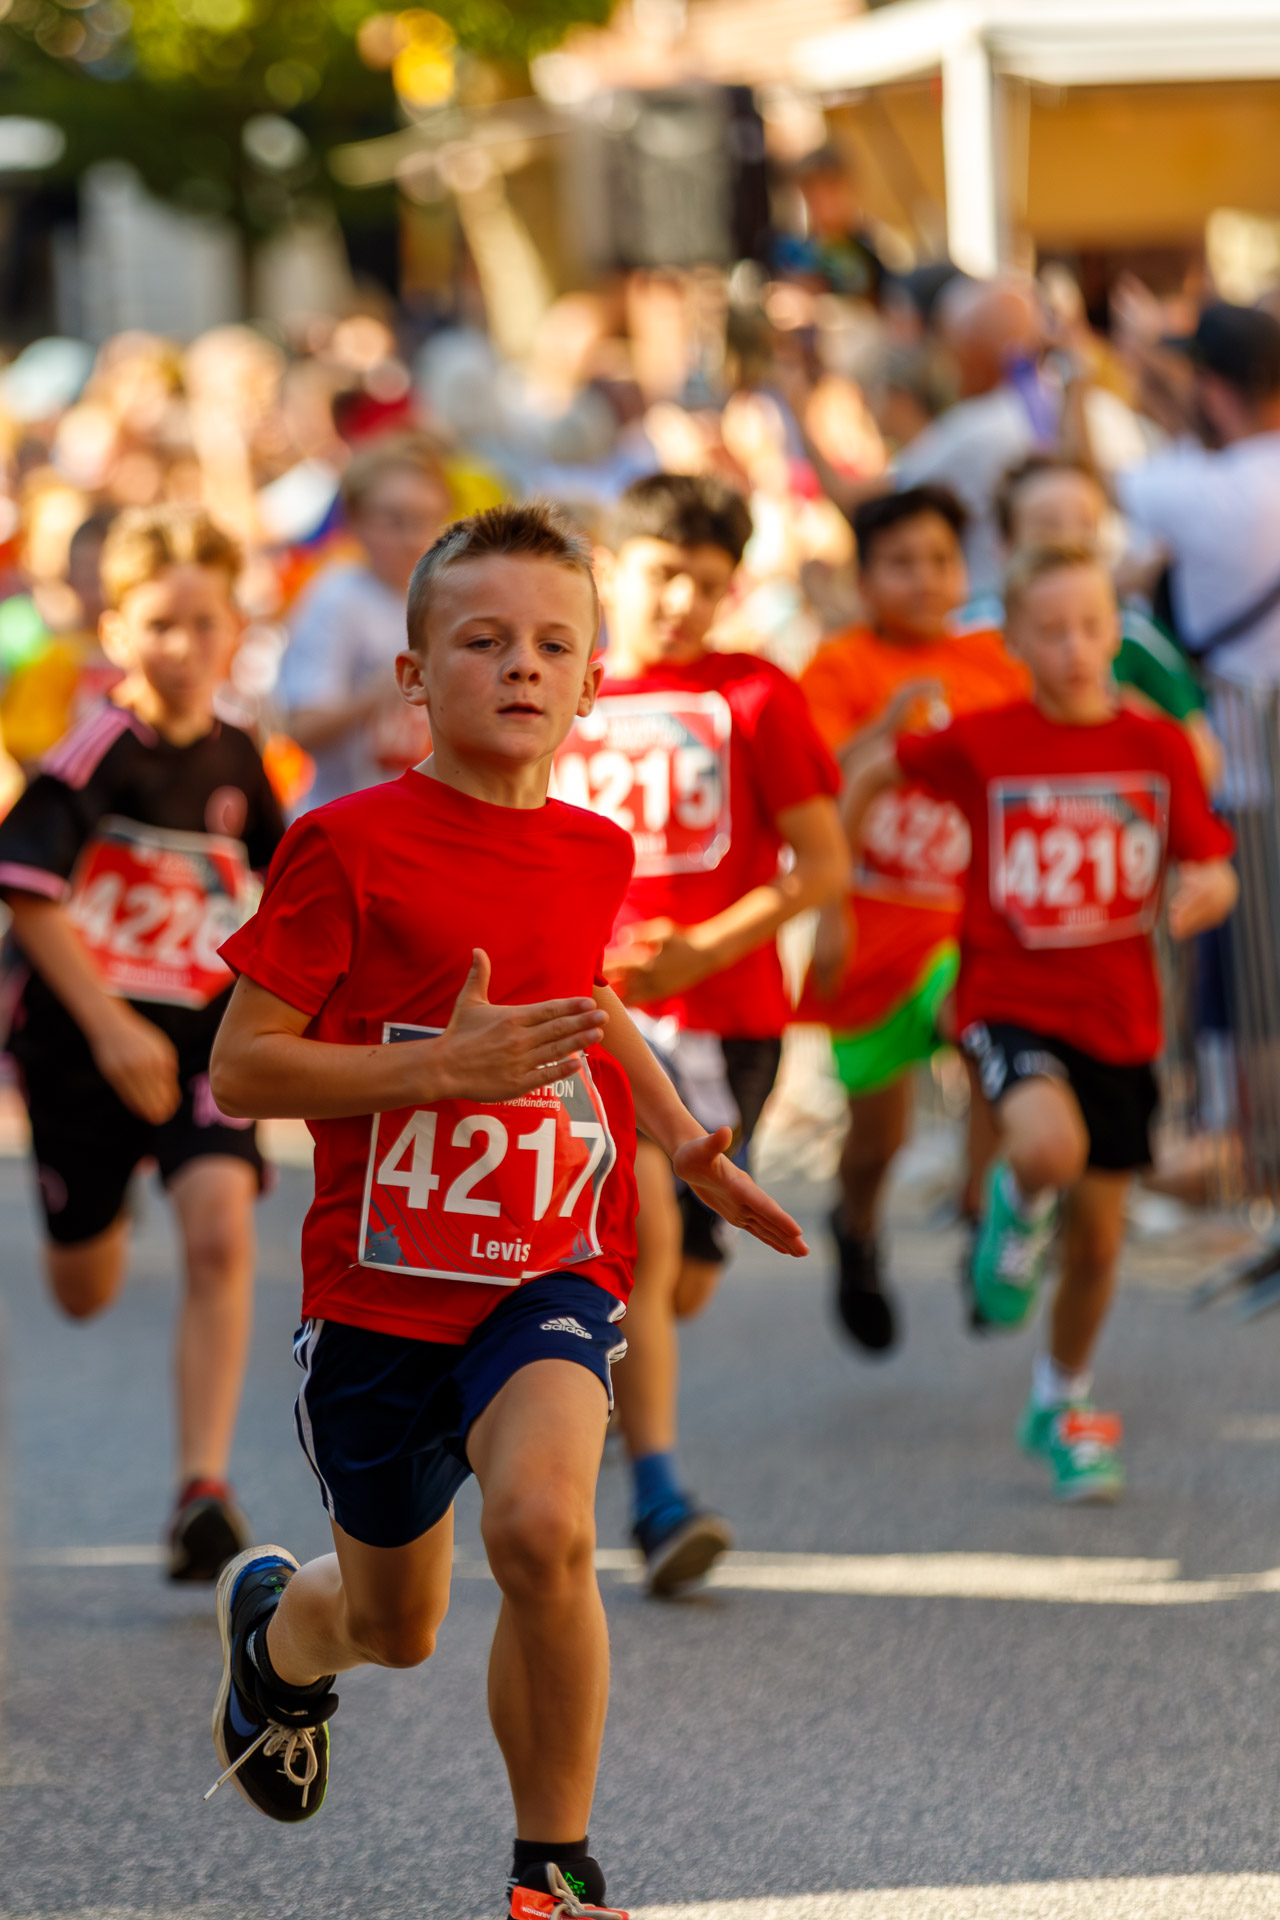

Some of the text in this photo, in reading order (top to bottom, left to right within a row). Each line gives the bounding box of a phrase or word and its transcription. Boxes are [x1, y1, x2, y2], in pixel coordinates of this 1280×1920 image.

[547, 747, 722, 832] 4215
[996, 821, 1160, 908] 4219
[377, 1110, 607, 1222] 4217
[471, 1233, 531, 1263] Levis
[540, 1323, 593, 1340] adidas
